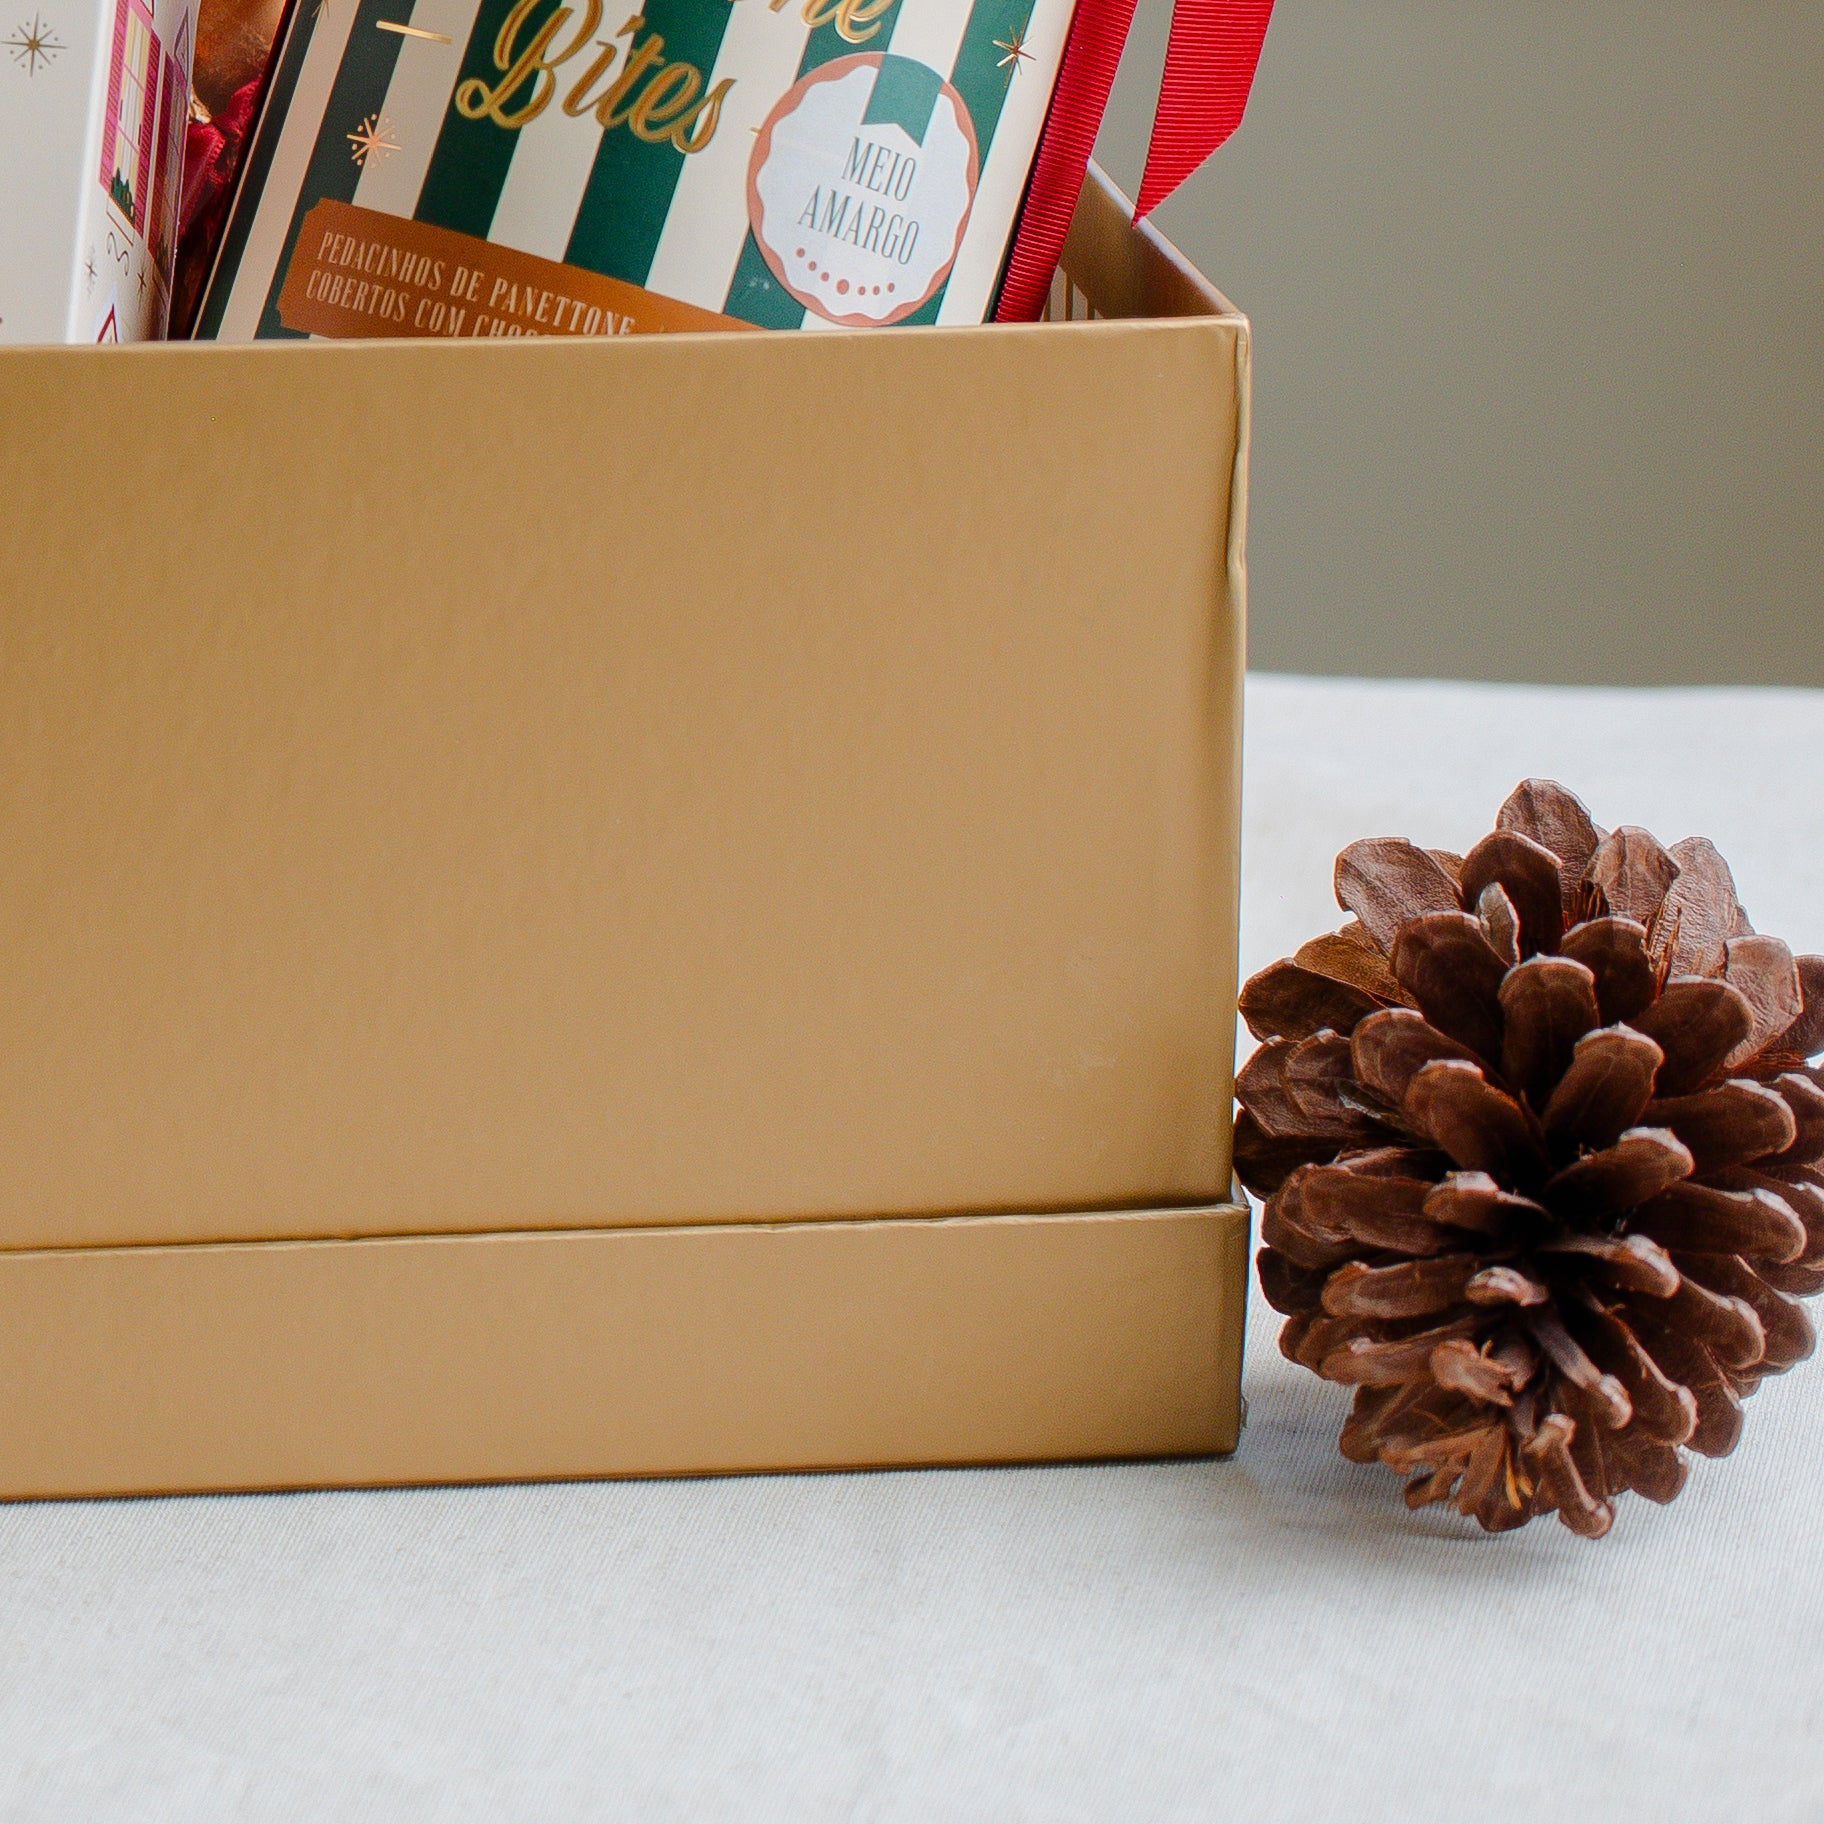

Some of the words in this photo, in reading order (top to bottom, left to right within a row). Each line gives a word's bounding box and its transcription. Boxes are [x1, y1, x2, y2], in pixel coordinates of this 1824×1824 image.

[841, 136, 917, 202] MEIO
[797, 184, 920, 265] AMARGO
[304, 269, 411, 322] COBERTOS
[414, 297, 466, 337] COM
[317, 231, 446, 289] PEDACINHOS
[450, 265, 484, 302] DE
[489, 277, 636, 336] PANETTONE
